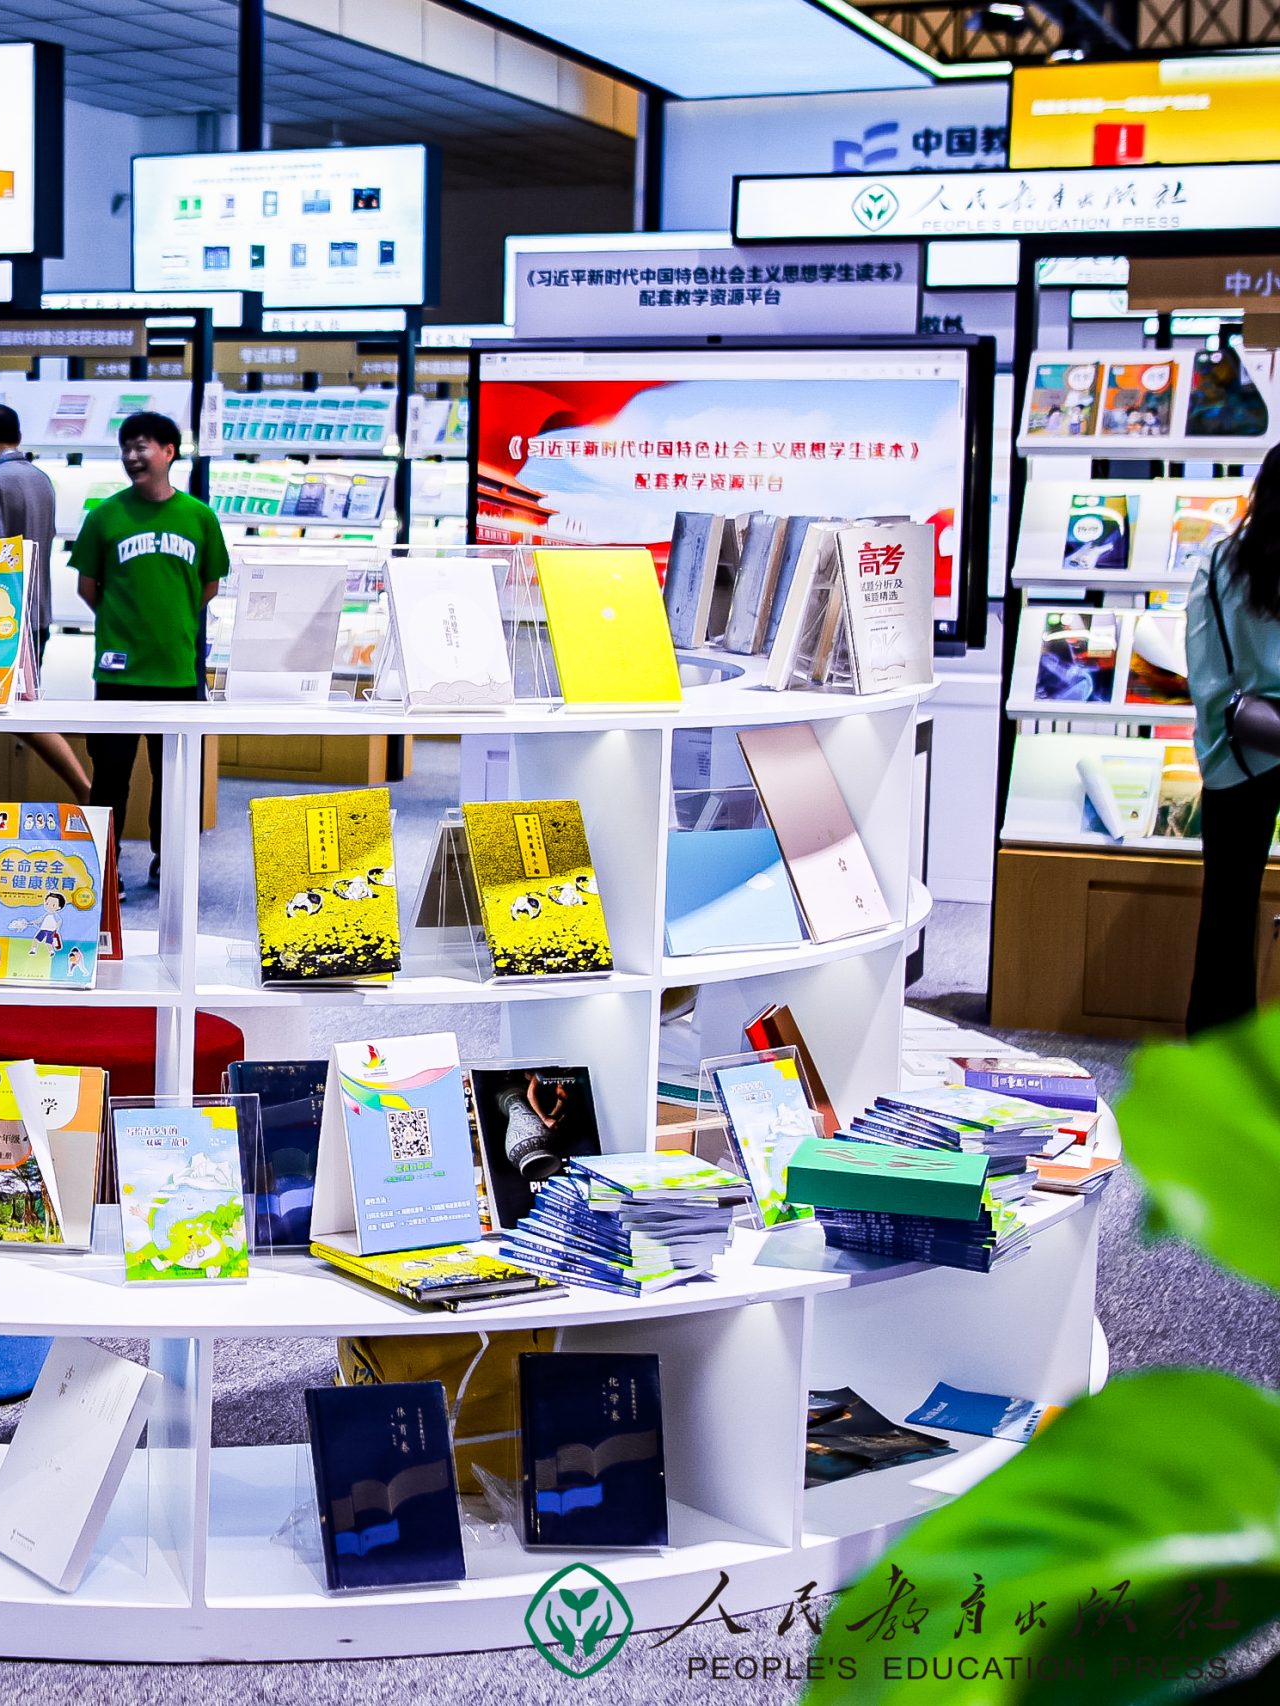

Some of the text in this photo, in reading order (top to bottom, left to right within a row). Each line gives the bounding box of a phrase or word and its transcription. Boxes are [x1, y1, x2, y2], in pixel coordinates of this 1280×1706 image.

[908, 178, 1188, 217] 人民教育出版社
[1012, 218, 1110, 231] EDUCATION
[1122, 216, 1181, 229] PRESS
[526, 261, 904, 288] 《习近平新时代中国特色社会主义思想学生读本》
[638, 288, 782, 308] 配套教学资源平台
[509, 435, 921, 461] 《习近平新时代中国特色社会主义思想学生读本》
[634, 472, 785, 492] 配套教学资源平台
[858, 541, 906, 577] 高考
[0, 858, 65, 875] 生命安全
[0, 874, 77, 891] 与健康教育
